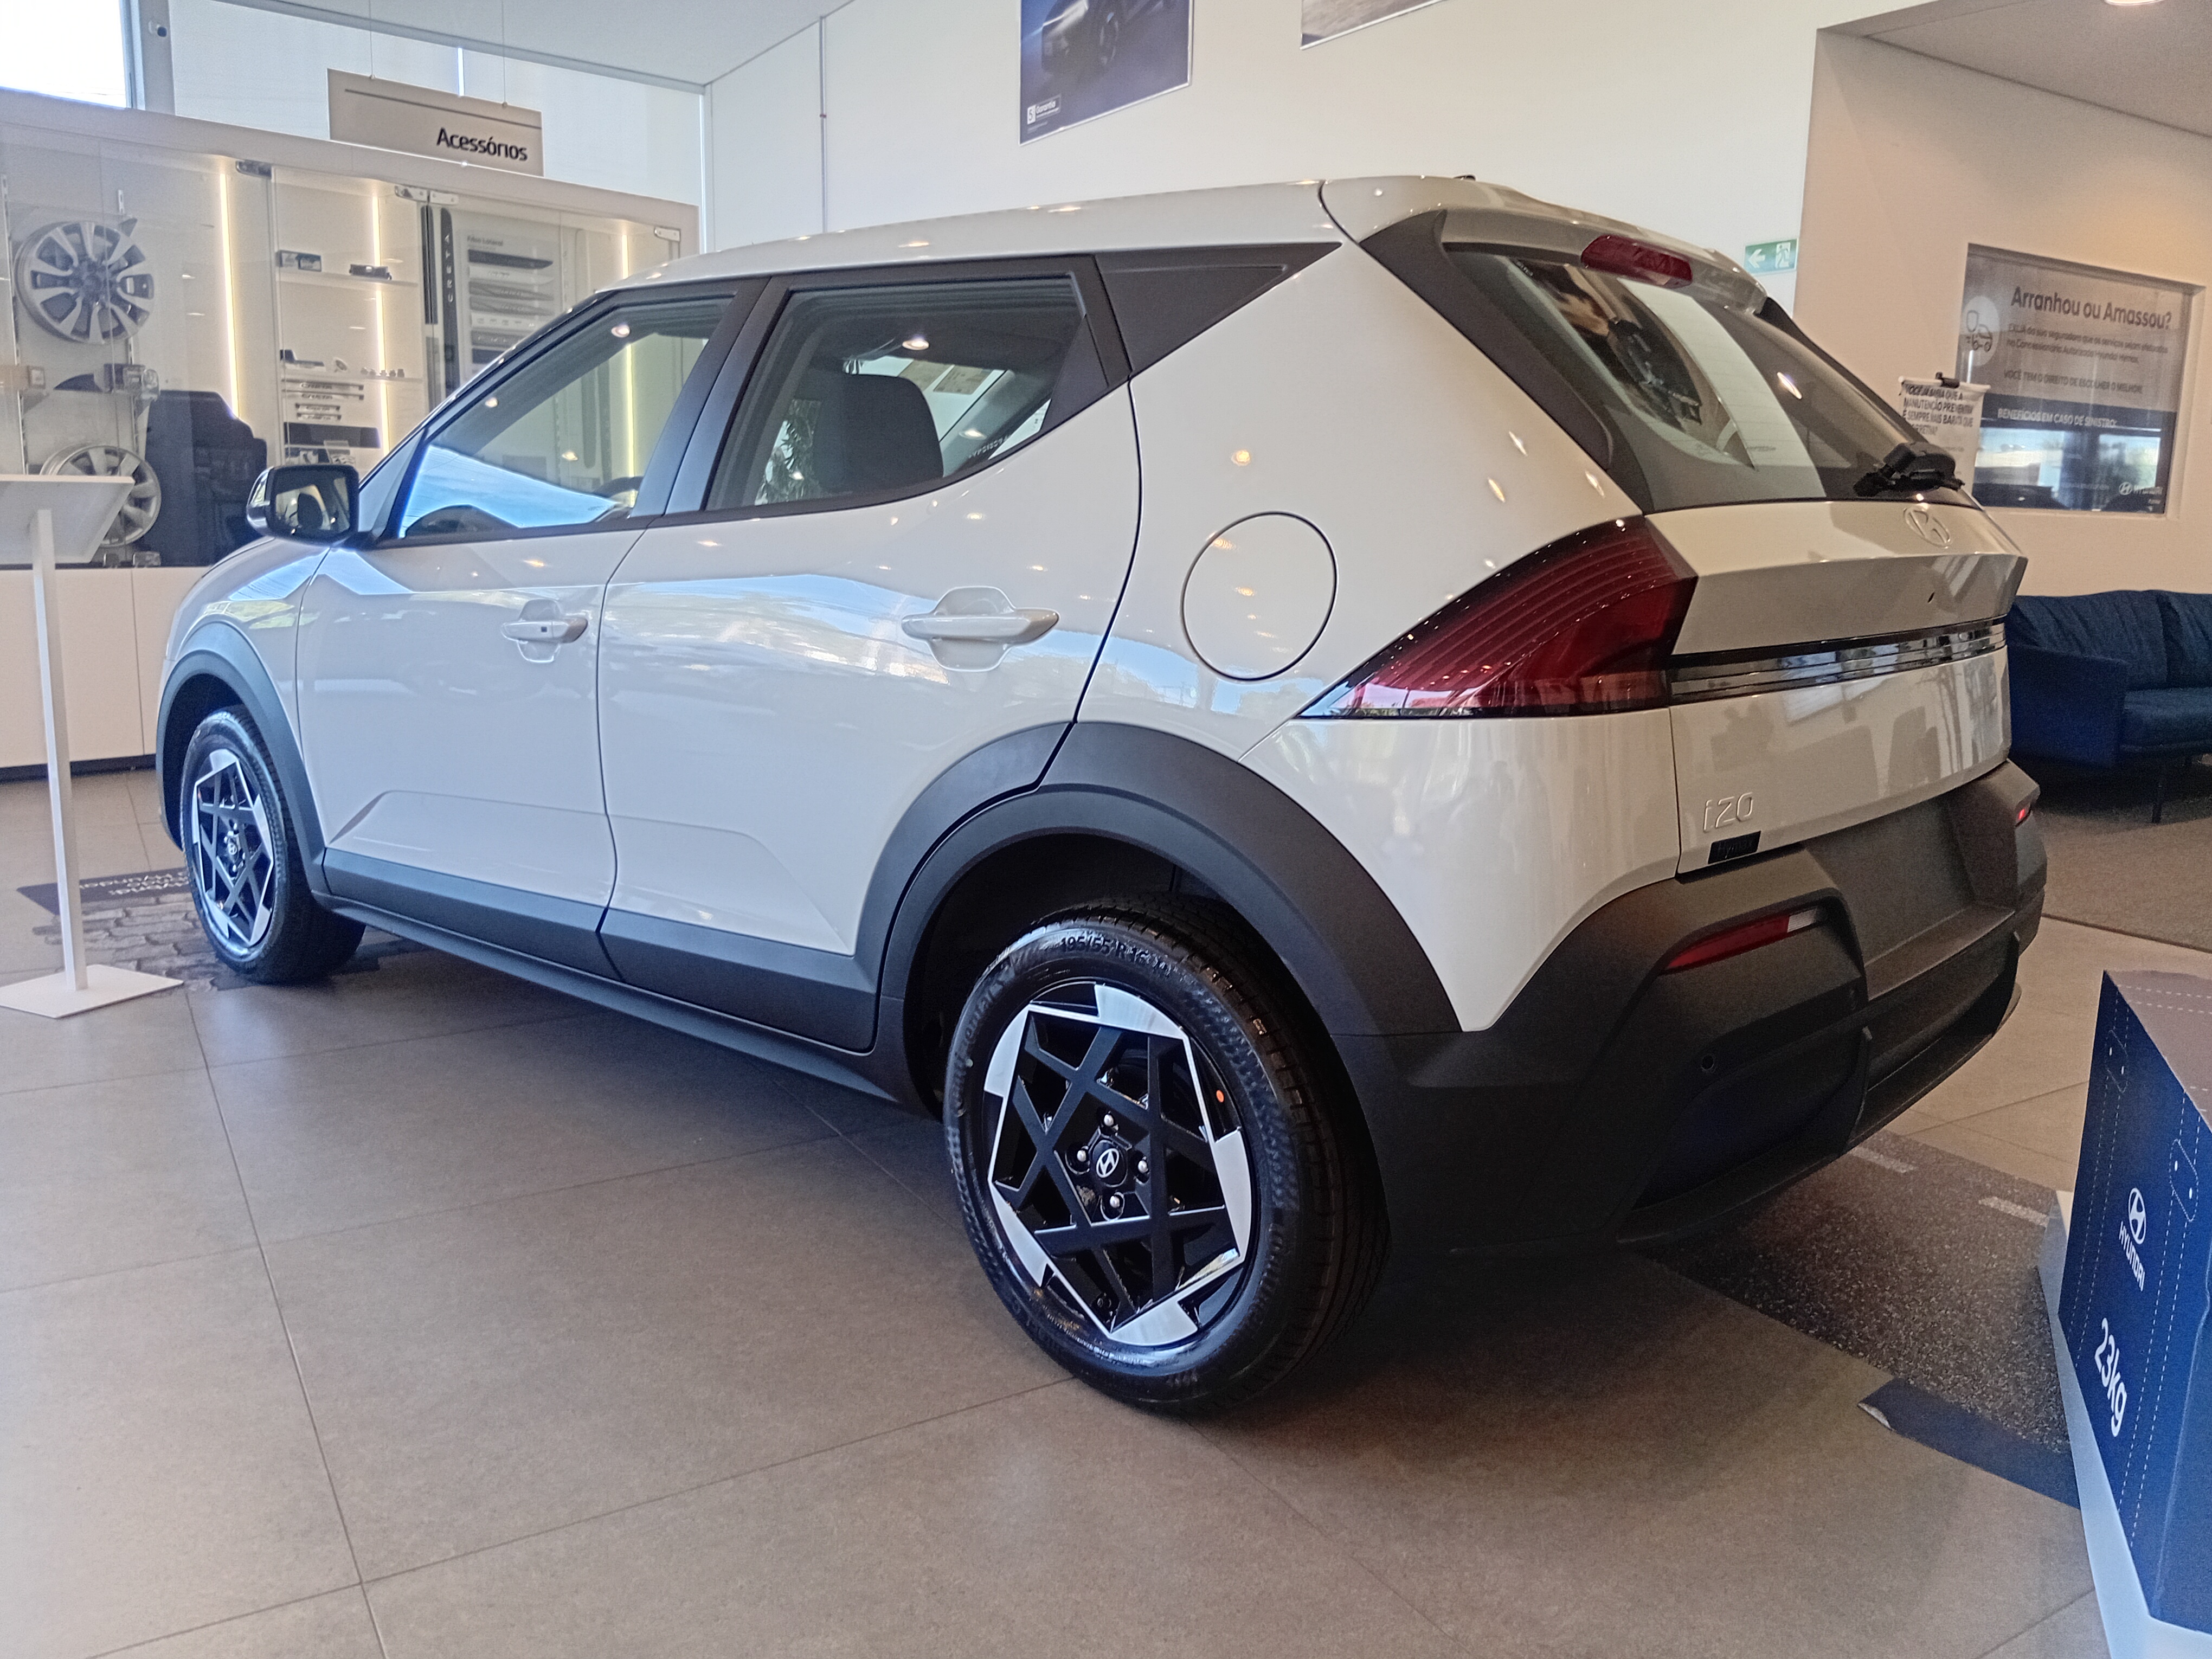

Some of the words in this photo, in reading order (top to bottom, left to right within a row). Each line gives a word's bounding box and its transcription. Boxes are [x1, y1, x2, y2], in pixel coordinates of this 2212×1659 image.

[436, 127, 528, 162] Acessórios
[444, 233, 454, 303] CRETA
[2011, 286, 2081, 316] Arranhou
[2083, 303, 2101, 319] ou
[2103, 302, 2172, 330] Amassou?
[1998, 408, 2041, 422] BENEFÍCIOS
[2054, 414, 2073, 425] CASO
[2074, 415, 2084, 426] DE
[1703, 791, 1754, 834] i20
[2119, 1220, 2145, 1291] HYUNDAI
[2094, 1317, 2127, 1437] 23kg
